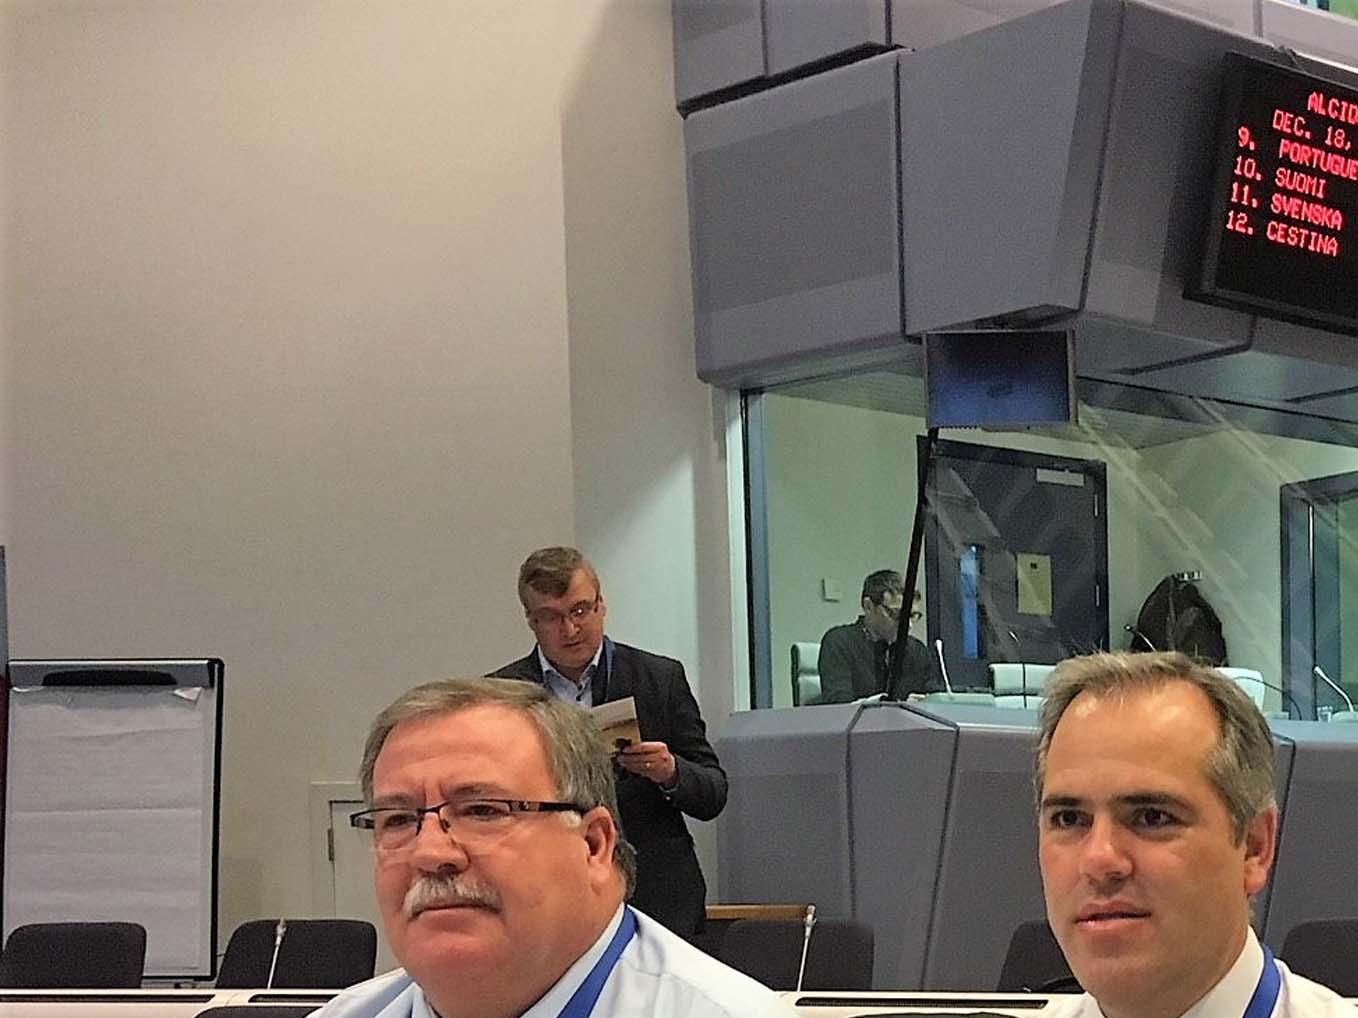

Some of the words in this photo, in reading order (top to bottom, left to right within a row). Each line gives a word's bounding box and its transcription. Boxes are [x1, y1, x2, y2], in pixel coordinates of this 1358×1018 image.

[1238, 126, 1255, 150] 9.
[1272, 109, 1312, 140] DEC.
[1324, 126, 1353, 151] 18,
[1233, 157, 1262, 181] 10.
[1274, 167, 1326, 199] SUOMI
[1230, 182, 1258, 208] 11.
[1271, 194, 1343, 231] SVENSKA
[1226, 210, 1254, 235] 12.
[1266, 222, 1338, 257] CESTINA
